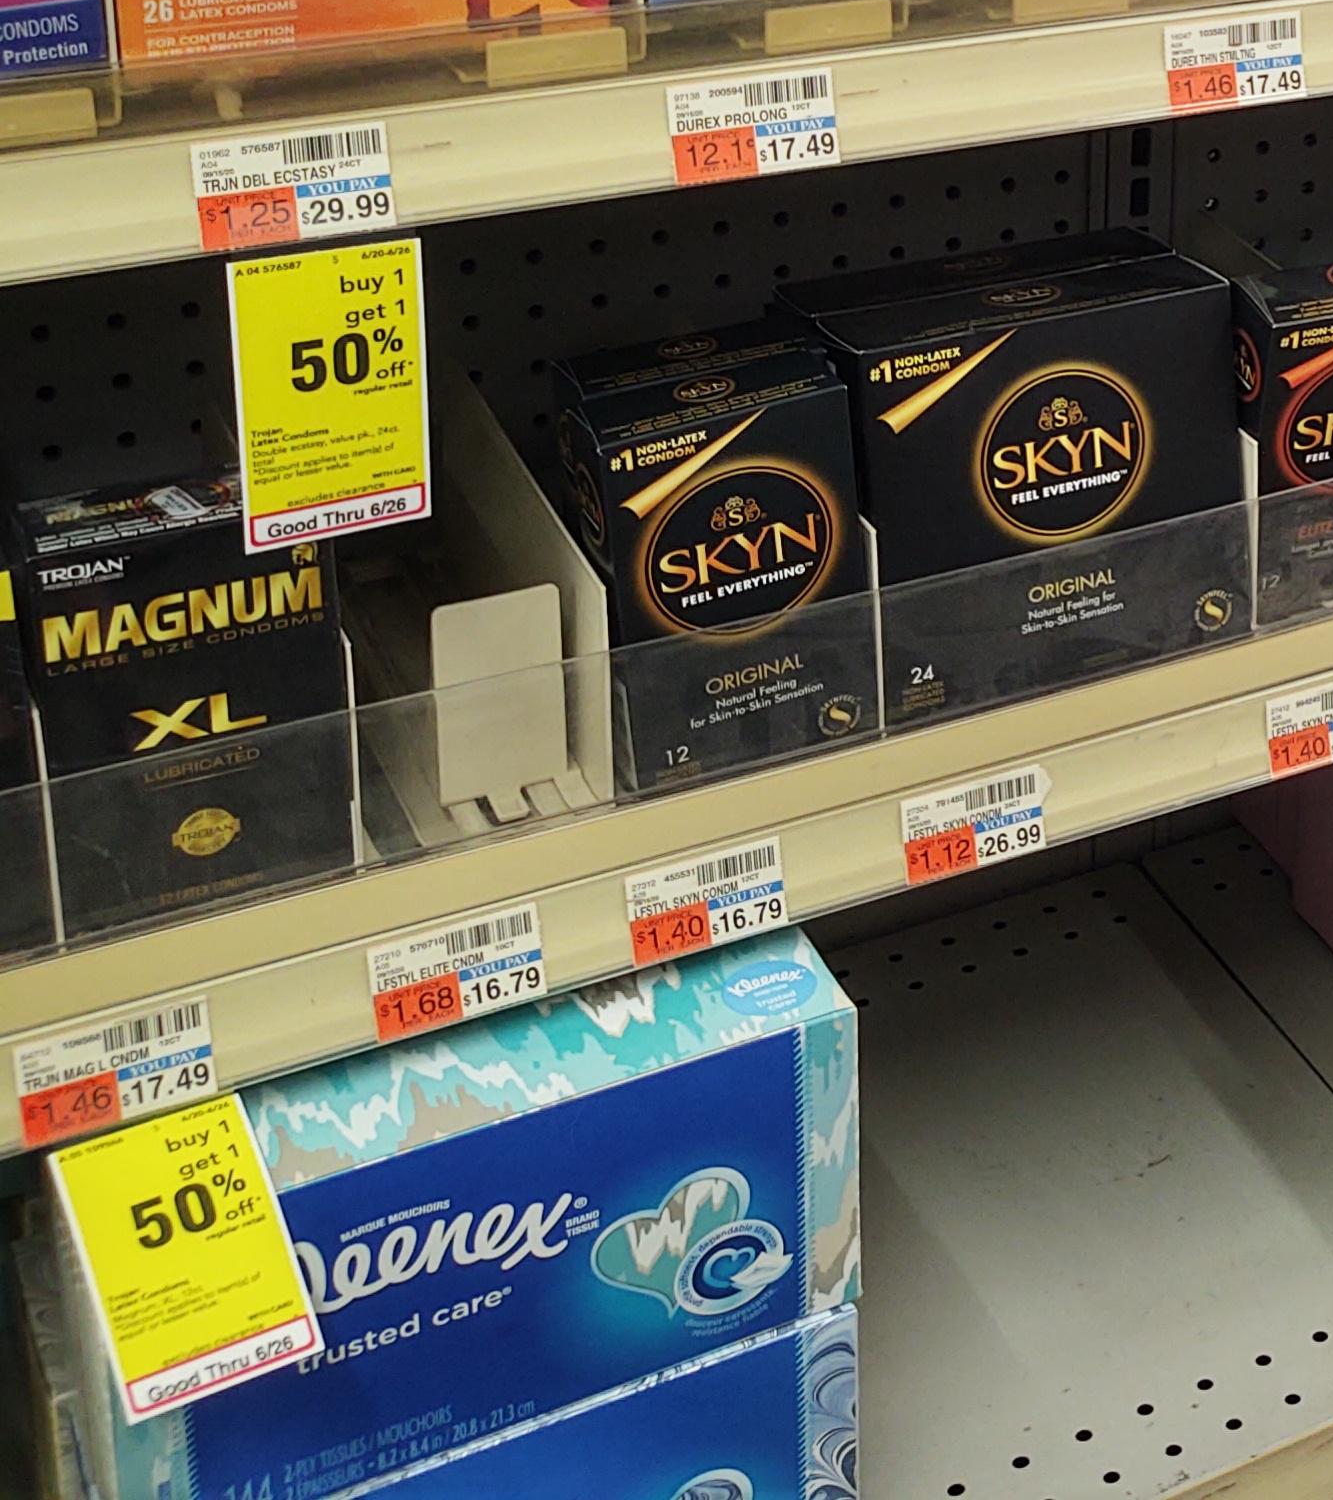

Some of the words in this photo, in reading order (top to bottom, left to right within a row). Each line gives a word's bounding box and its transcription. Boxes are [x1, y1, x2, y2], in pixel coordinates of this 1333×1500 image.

[143, 0, 174, 24] 26
[4, 41, 88, 64] Protection
[677, 117, 720, 133] DUREX
[725, 108, 787, 127] PROLONG
[760, 134, 834, 163] $17.49
[203, 178, 238, 194] TRJN
[241, 171, 269, 188] DBL
[276, 165, 335, 185] ECSTASY
[301, 192, 391, 226] $29.99
[992, 425, 1131, 489] SKYN
[38, 558, 124, 584] TROJAN
[659, 518, 818, 592] SKYN
[681, 589, 714, 608] FEEL
[718, 564, 805, 599] EVERYTHING
[1028, 569, 1115, 603] ORIGINAL
[42, 566, 324, 664] MAGNUM
[131, 698, 268, 751] XL
[144, 745, 260, 785] LUBRICATED
[978, 824, 1041, 858] $26.99
[122, 1064, 211, 1108] $17.49
[298, 1315, 422, 1375] trusted
[432, 1291, 502, 1330] care
